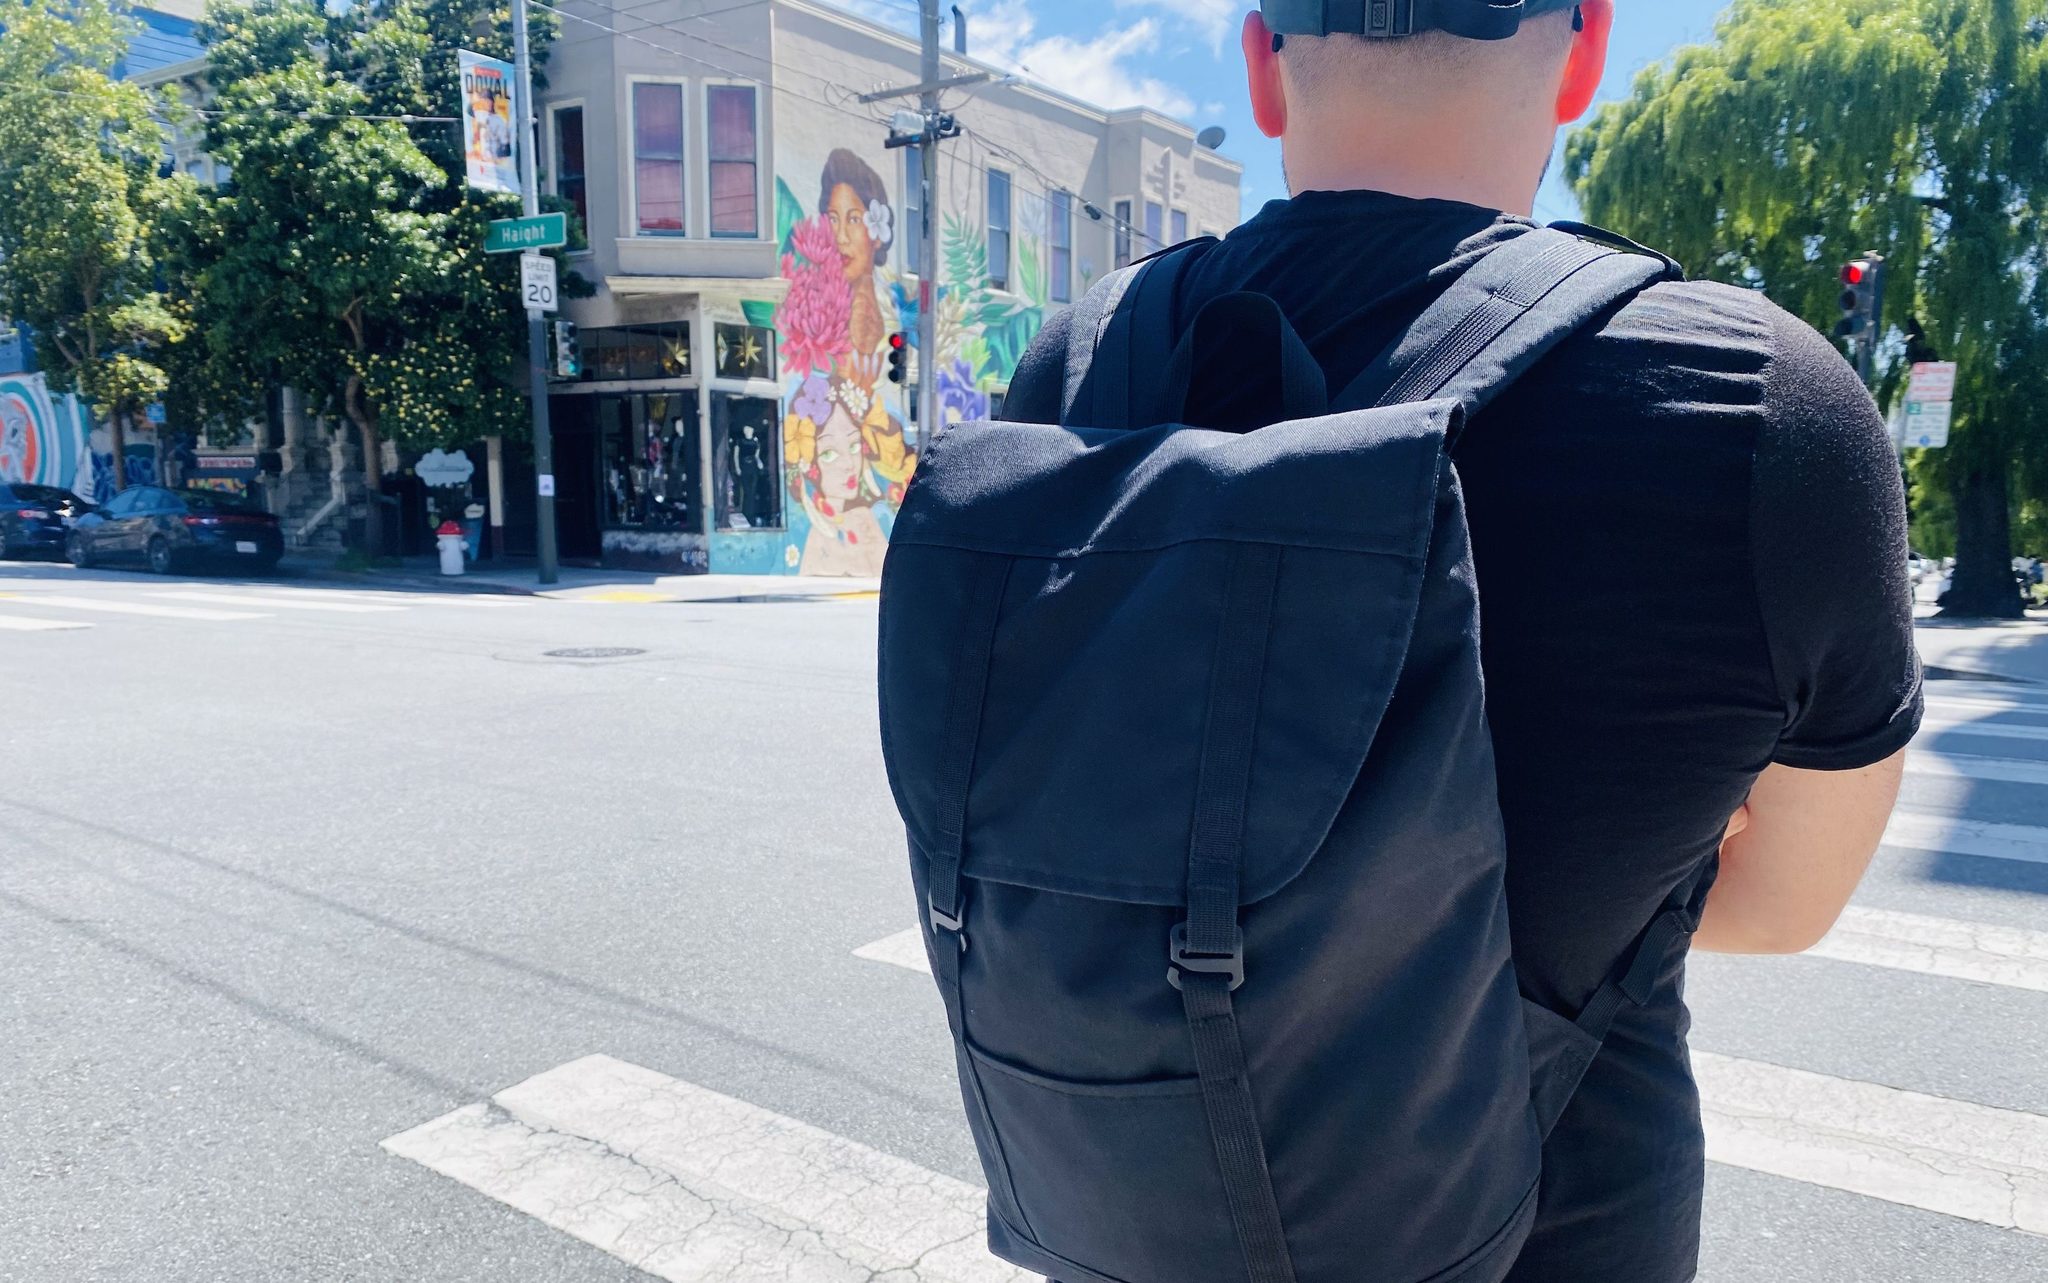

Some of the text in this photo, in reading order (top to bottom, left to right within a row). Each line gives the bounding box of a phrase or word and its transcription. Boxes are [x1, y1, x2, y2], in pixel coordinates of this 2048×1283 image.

[502, 224, 545, 244] Haight
[524, 261, 552, 272] SPEED
[528, 272, 549, 282] LIMIT
[528, 283, 552, 303] 20
